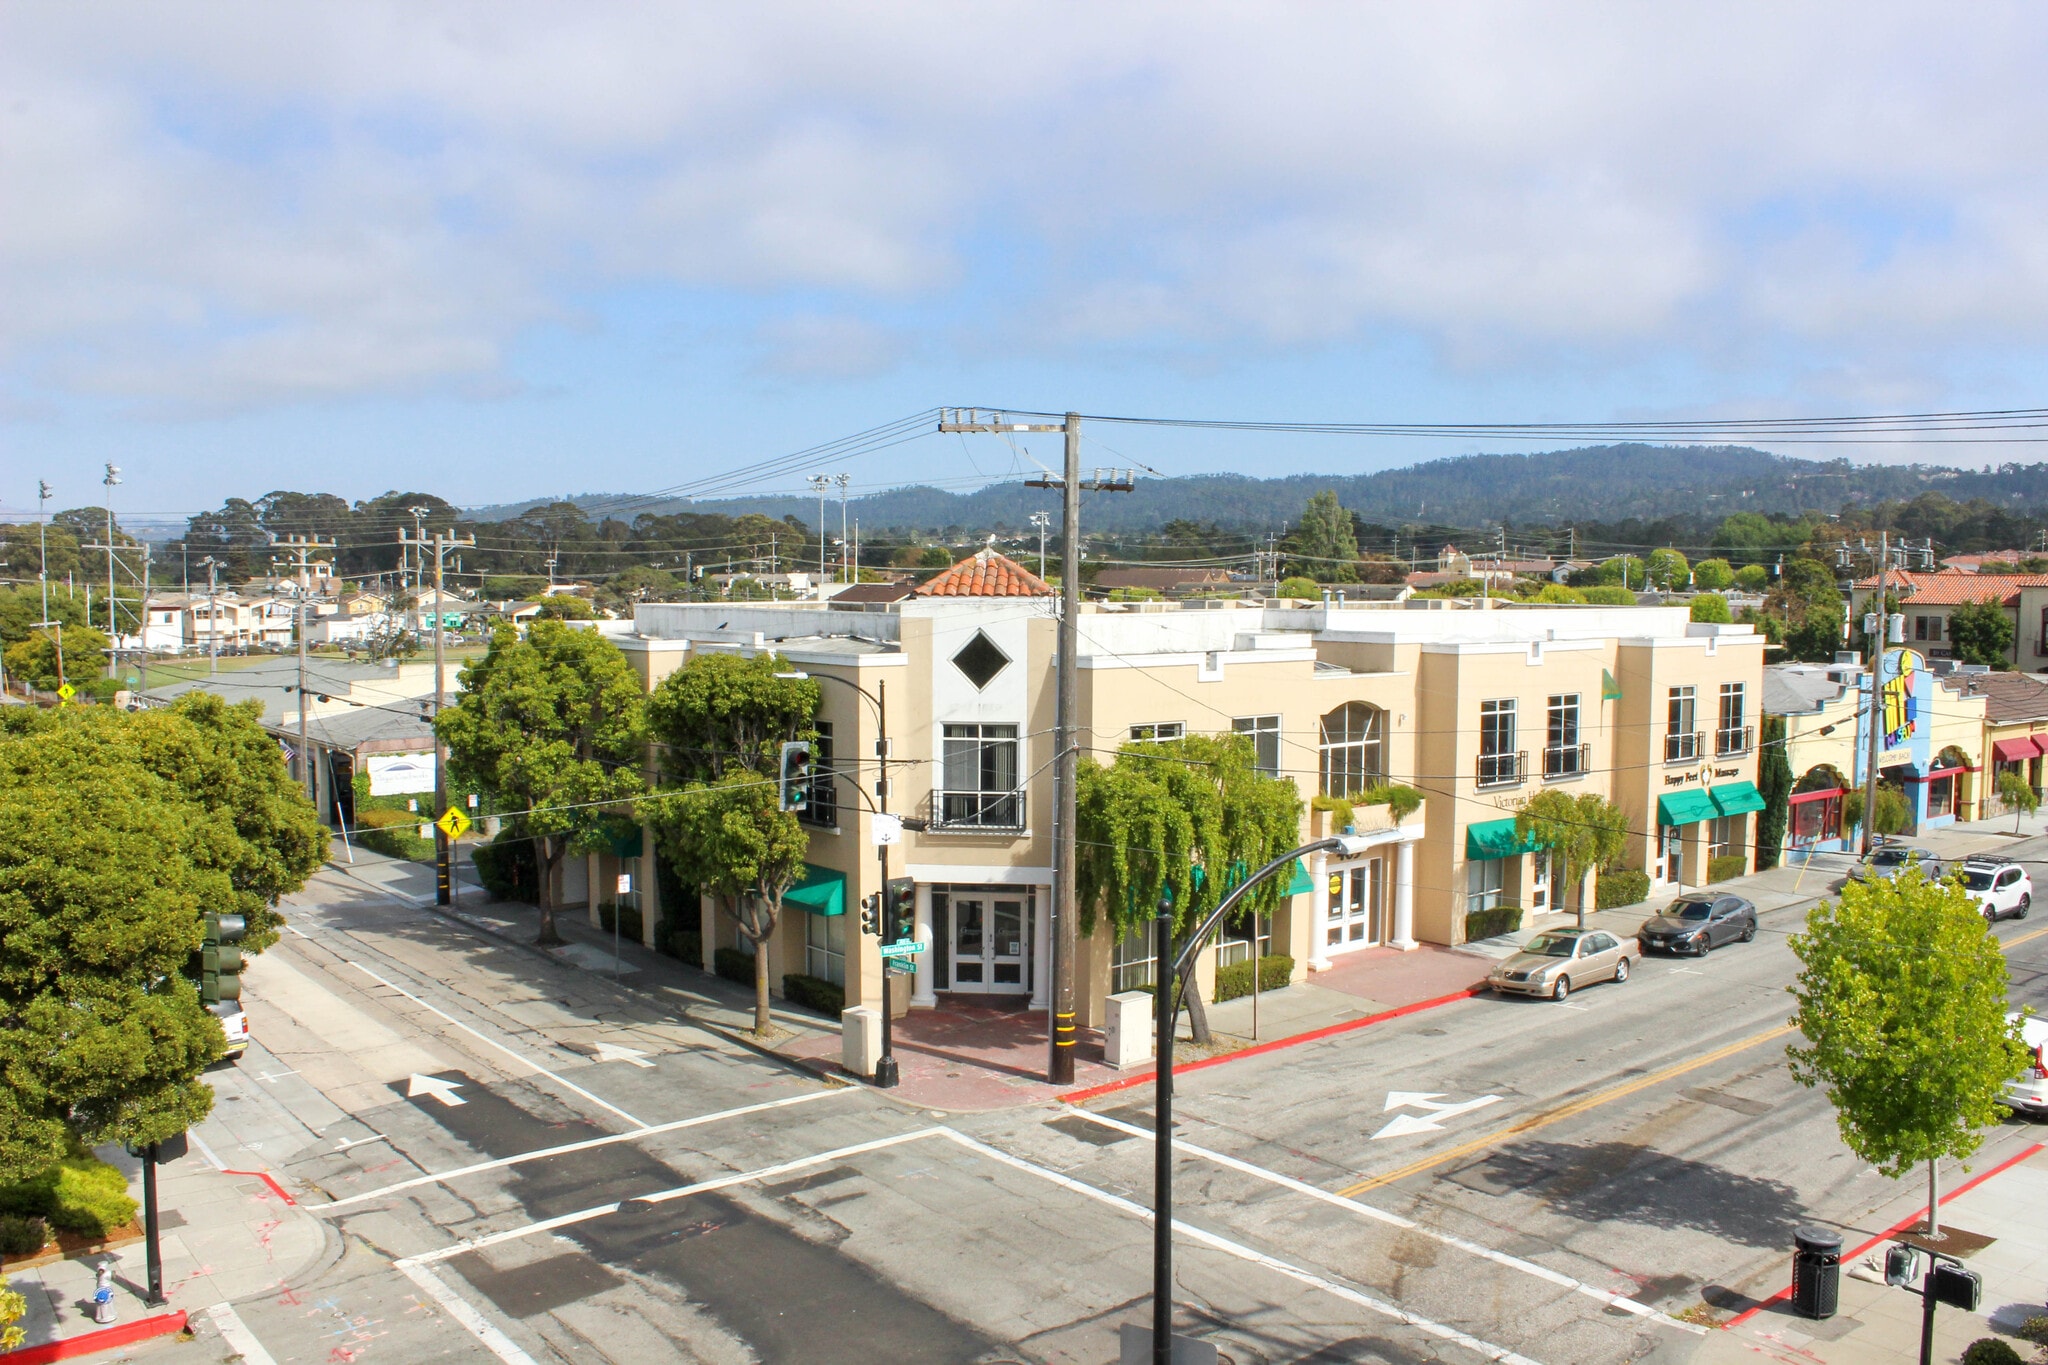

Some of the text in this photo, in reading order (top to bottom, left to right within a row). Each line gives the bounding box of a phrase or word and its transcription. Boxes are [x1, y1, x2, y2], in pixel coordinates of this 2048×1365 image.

[1899, 752, 1910, 761] BACK
[1664, 775, 1684, 787] Happy
[1685, 771, 1698, 783] Feet
[1493, 795, 1527, 808] Victorian
[883, 943, 923, 954] Washington St
[892, 959, 909, 969] Franklin
